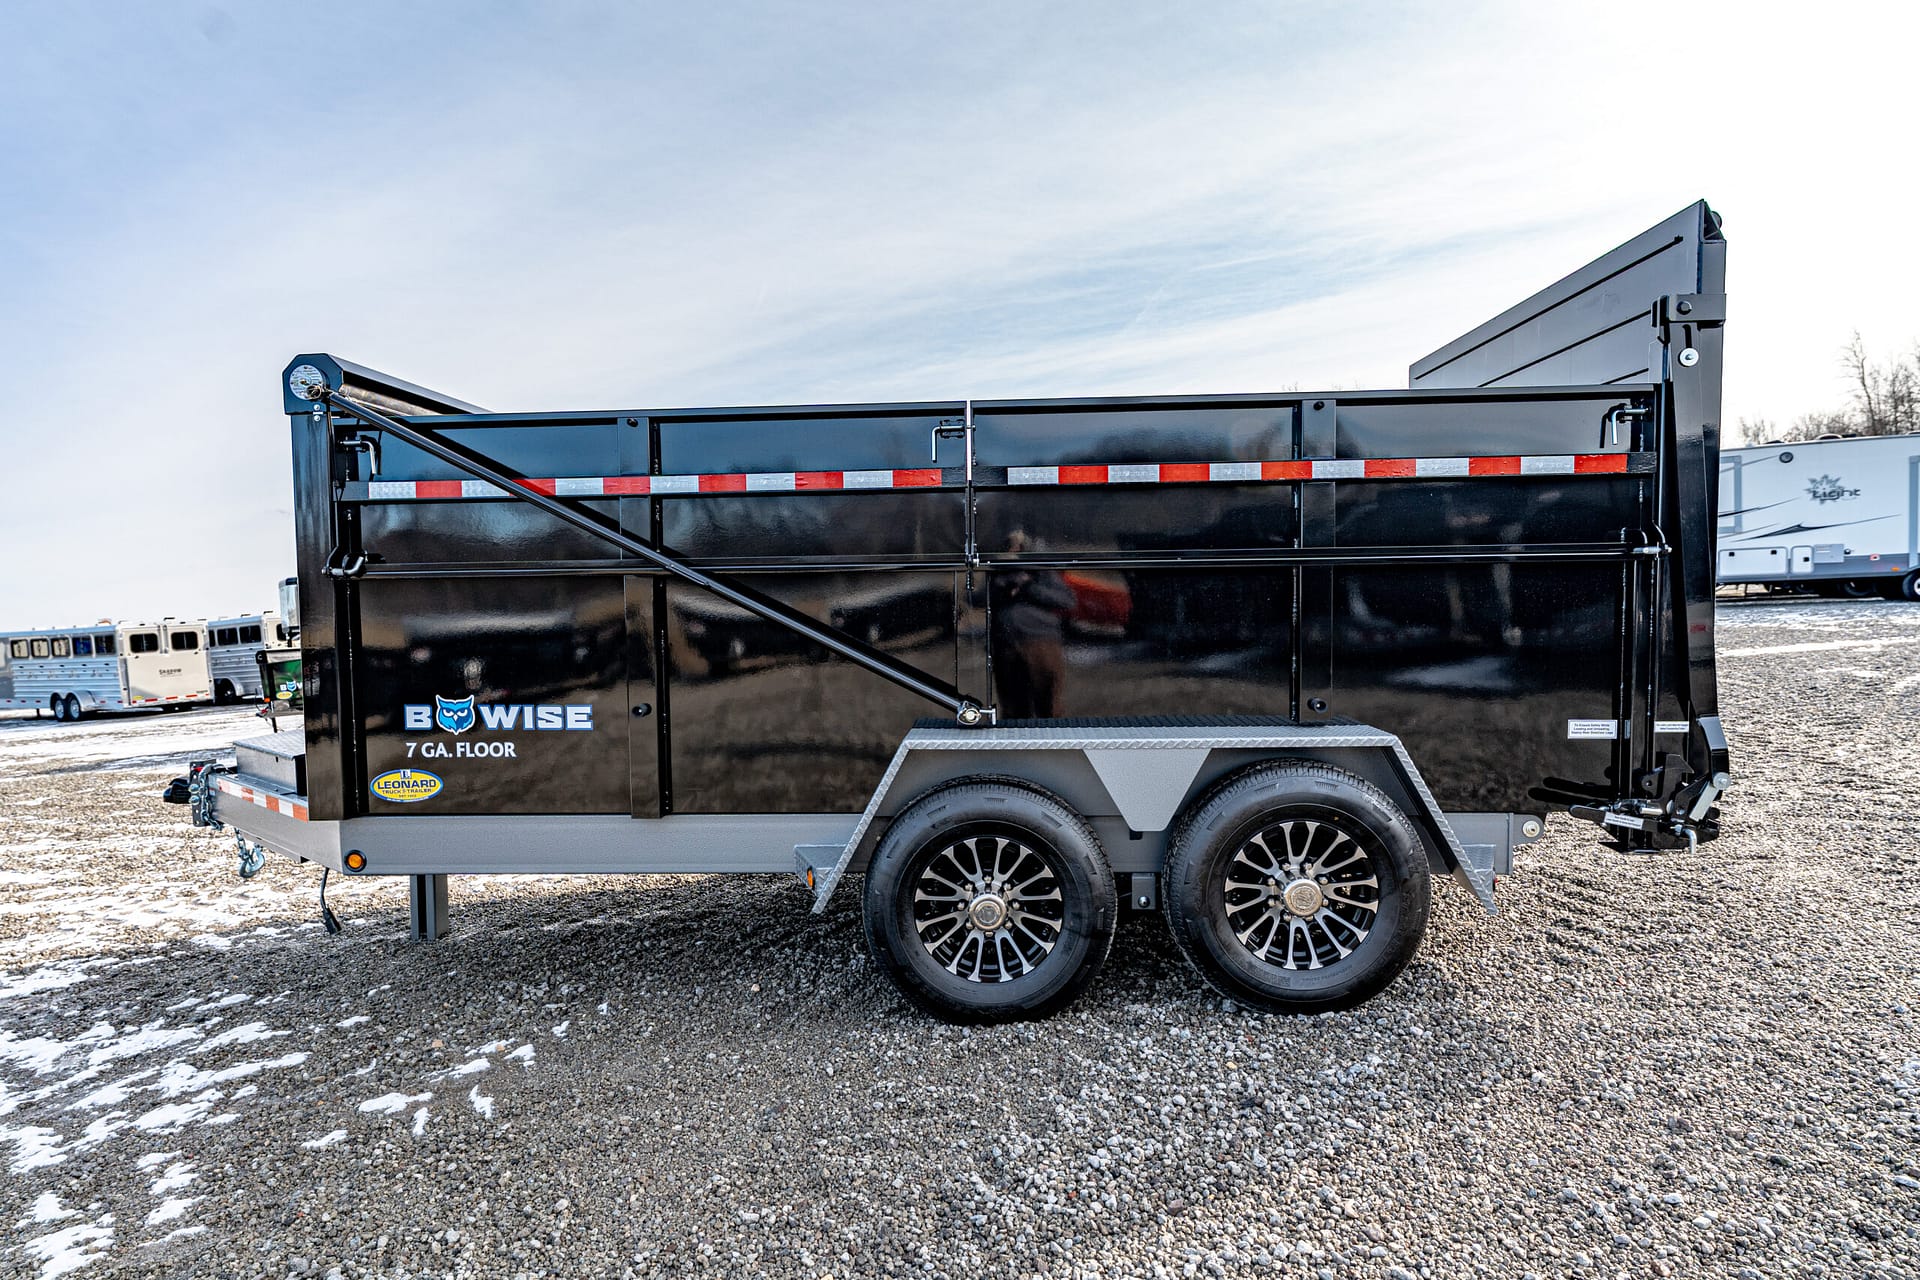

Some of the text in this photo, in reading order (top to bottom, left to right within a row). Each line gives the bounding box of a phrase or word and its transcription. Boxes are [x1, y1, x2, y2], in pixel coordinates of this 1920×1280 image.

[405, 741, 517, 759] 7 GA. FLOOR
[377, 779, 437, 790] LEONARD
